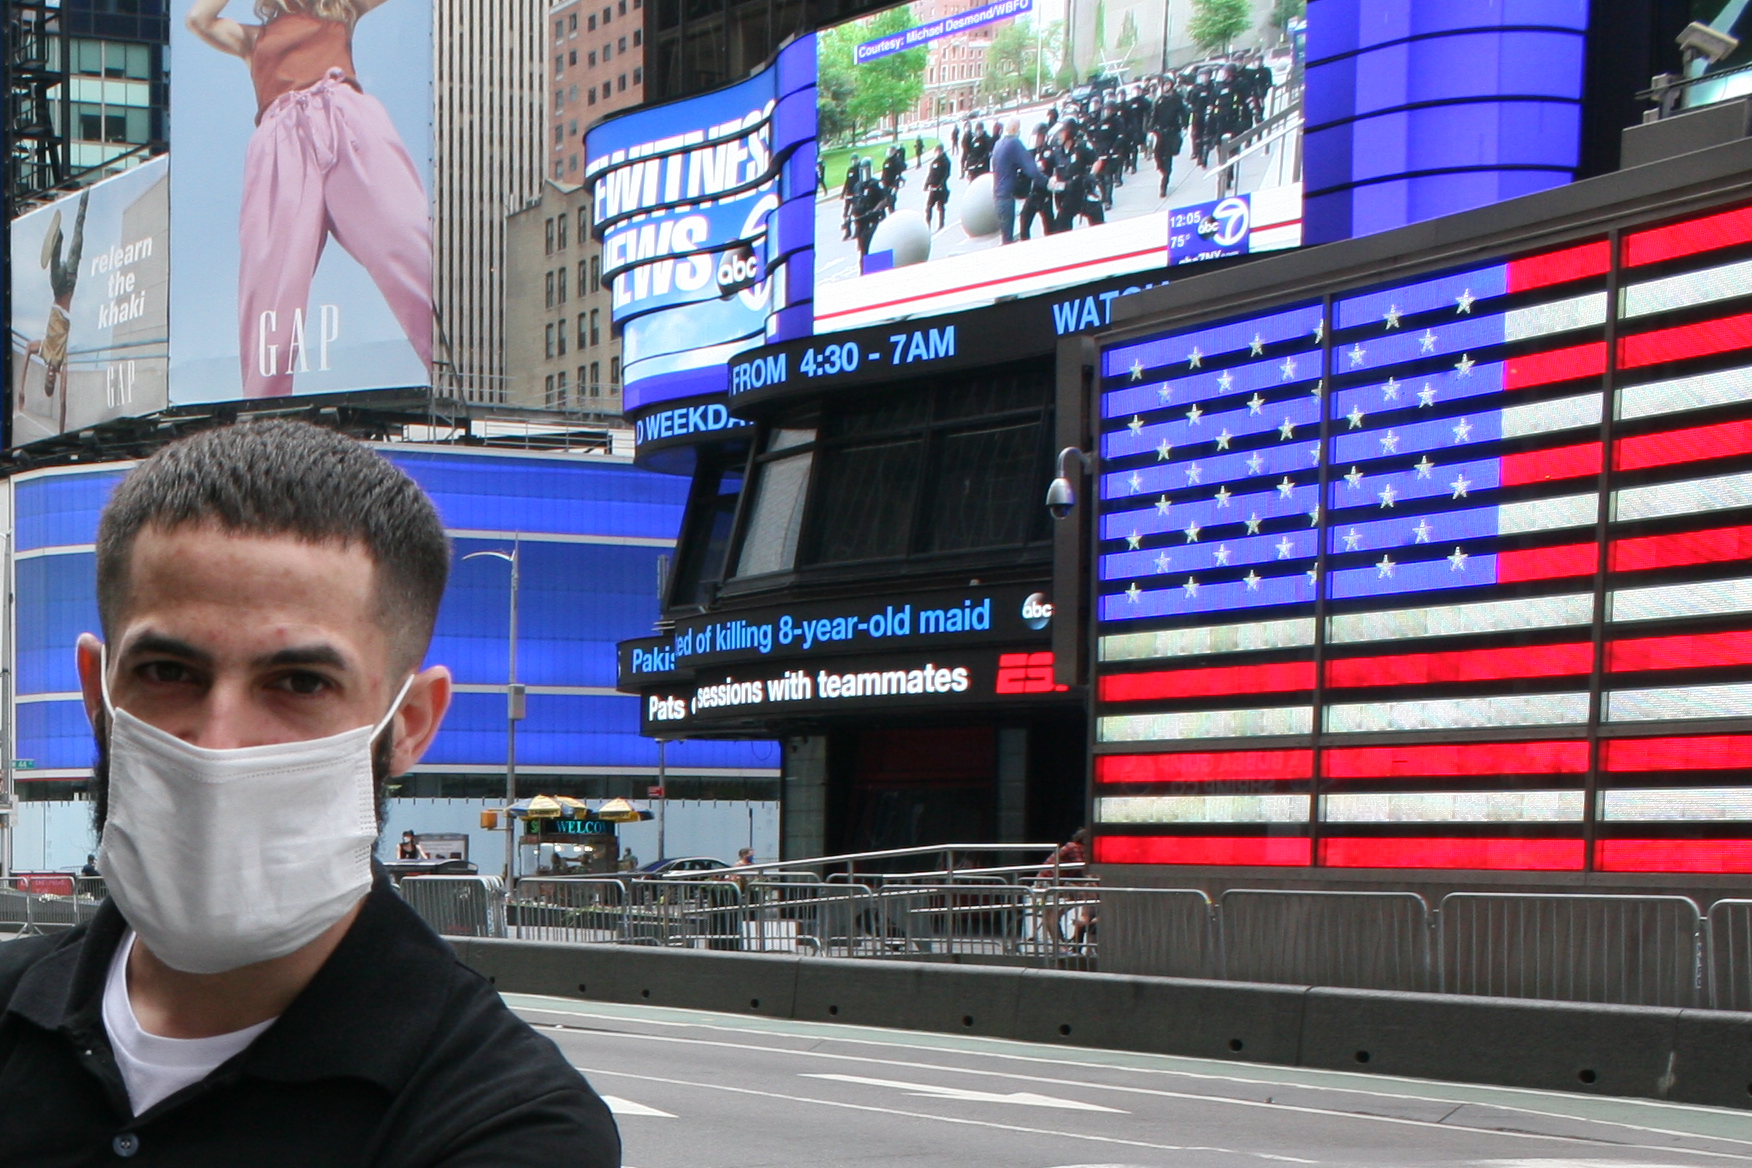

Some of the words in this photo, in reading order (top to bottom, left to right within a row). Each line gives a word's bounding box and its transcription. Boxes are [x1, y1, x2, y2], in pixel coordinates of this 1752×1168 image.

[859, 38, 905, 59] Courtesy:
[906, 23, 943, 44] Michael
[1171, 210, 1201, 228] 12:05
[1197, 220, 1219, 235] abc
[91, 236, 153, 277] relearn
[717, 254, 757, 287] abc
[108, 270, 135, 299] the
[98, 290, 145, 329] khaki
[259, 304, 339, 377] GAP
[732, 353, 787, 397] FROM
[800, 342, 860, 379] 4:30
[889, 327, 956, 366] 7AM
[106, 360, 135, 409] GAP
[696, 624, 712, 654] of
[716, 620, 772, 654] killing
[778, 605, 911, 650] 8-year-old
[919, 598, 991, 635] maid
[1022, 601, 1055, 620] abc
[698, 677, 763, 709] sessions
[767, 669, 811, 702] with
[817, 663, 969, 698] teammates
[649, 696, 686, 721] Pats
